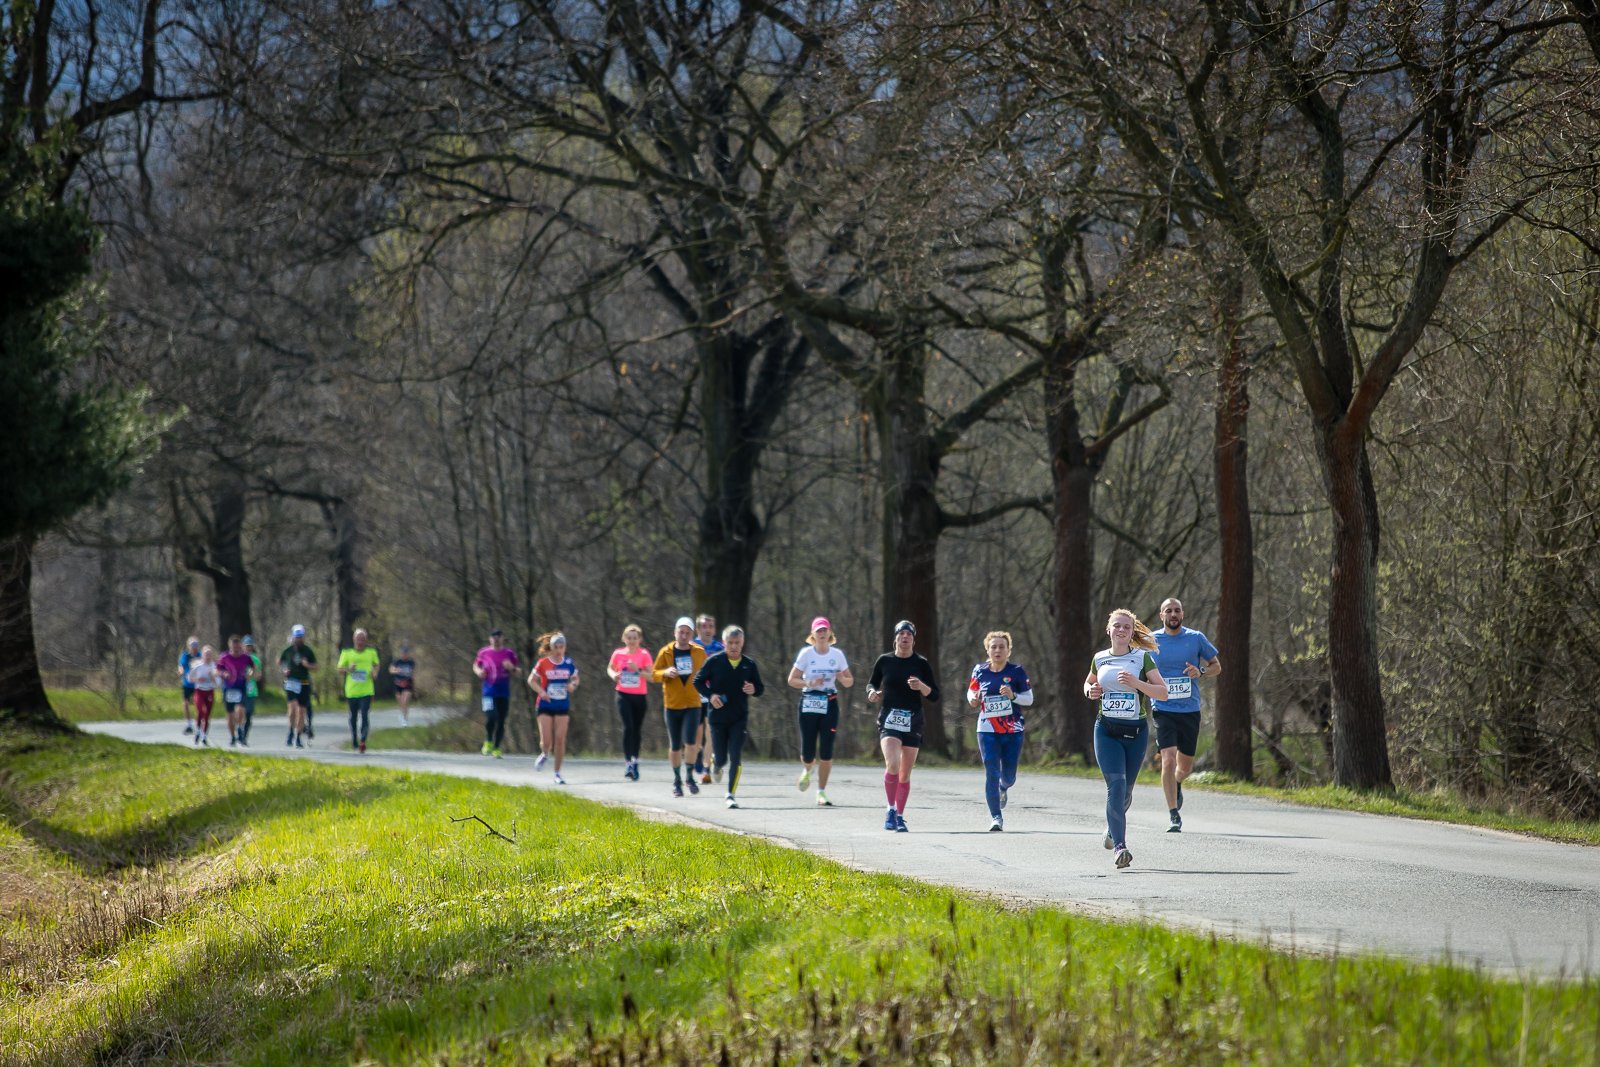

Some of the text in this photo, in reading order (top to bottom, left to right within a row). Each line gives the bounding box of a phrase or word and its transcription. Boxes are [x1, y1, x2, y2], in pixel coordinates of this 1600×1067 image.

[1169, 684, 1184, 692] 816
[989, 702, 1003, 711] 831
[1109, 700, 1126, 709] 297
[892, 716, 905, 724] 354
